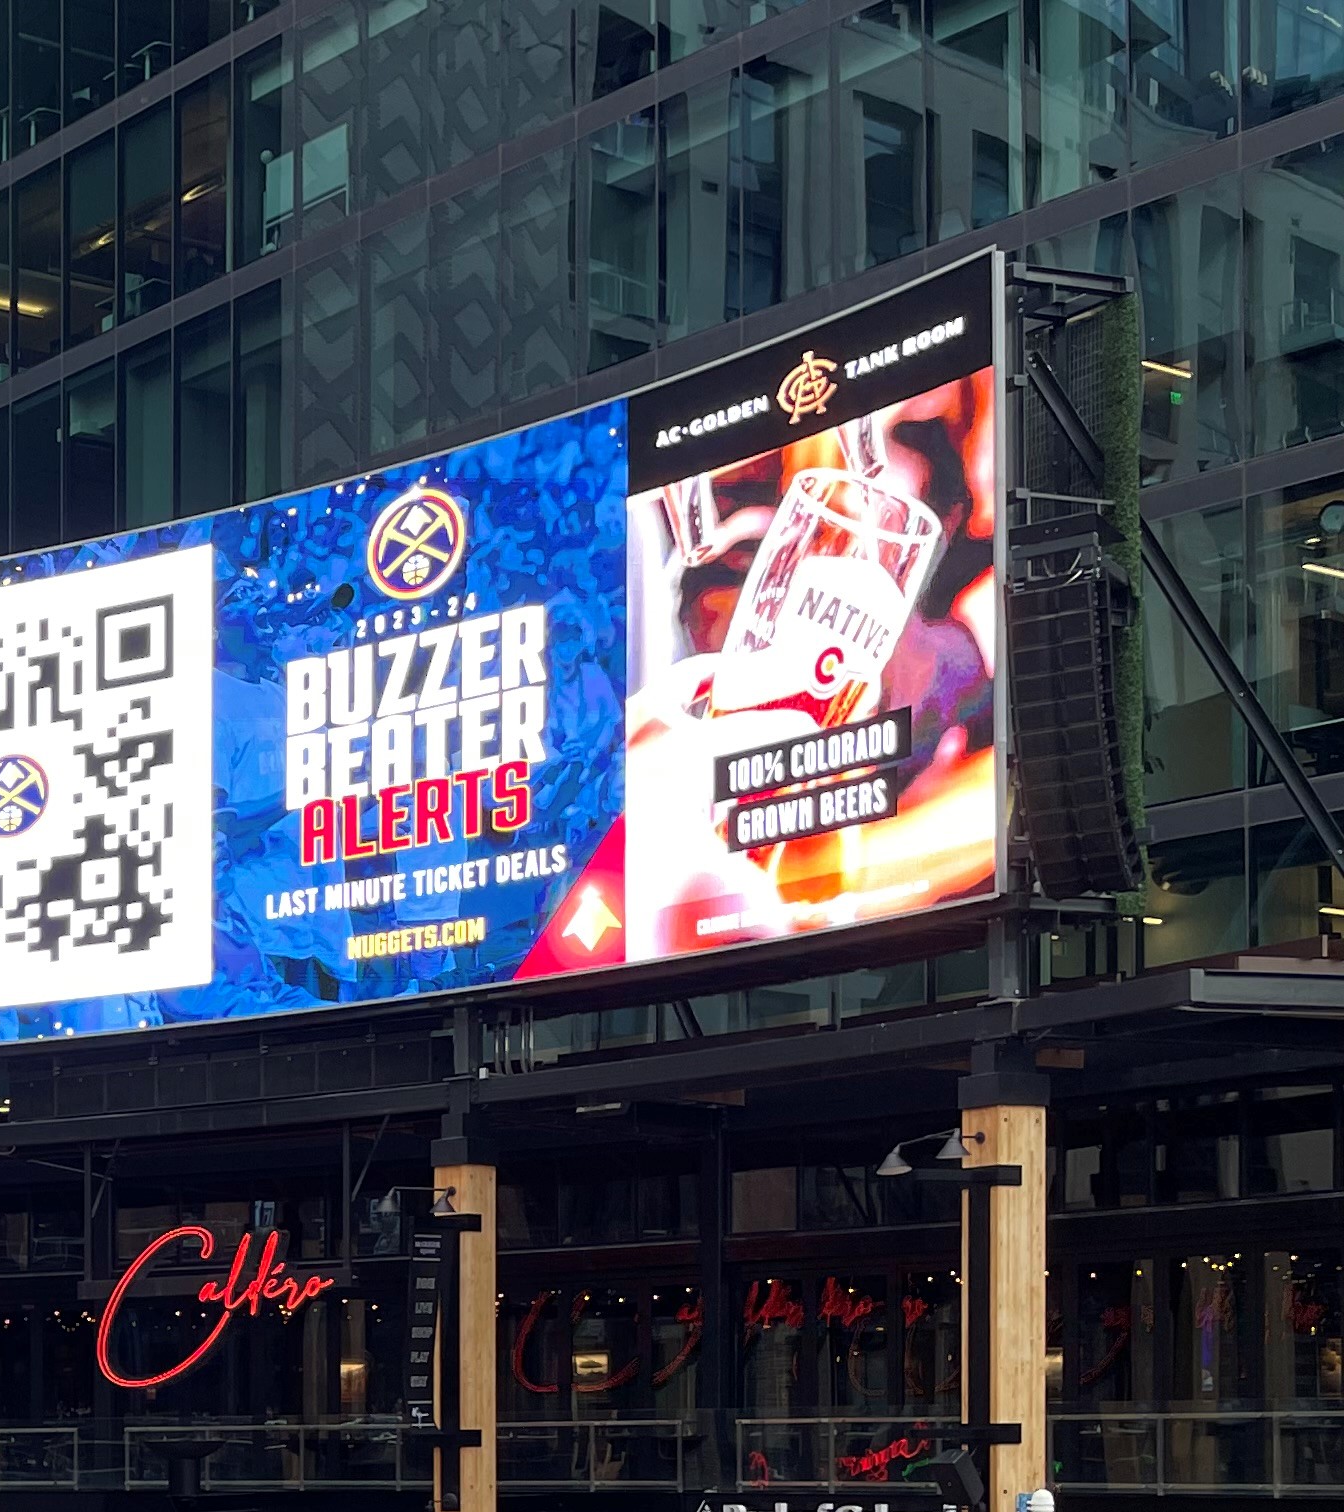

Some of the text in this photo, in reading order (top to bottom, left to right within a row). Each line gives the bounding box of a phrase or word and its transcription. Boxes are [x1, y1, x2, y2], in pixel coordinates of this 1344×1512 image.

[845, 317, 965, 378] TANK ROOM
[356, 592, 476, 638] 2023-24
[798, 588, 890, 658] NATIVE
[286, 604, 547, 736] BUZZER
[286, 686, 546, 811] BEATER
[728, 720, 897, 792] 100% COLORADO
[300, 760, 531, 867] ALERTS
[738, 778, 887, 843] GROWN BEERS
[266, 845, 567, 919] LAST MINUTE TICKET DEALS
[347, 918, 485, 959] NUGGETS.COM
